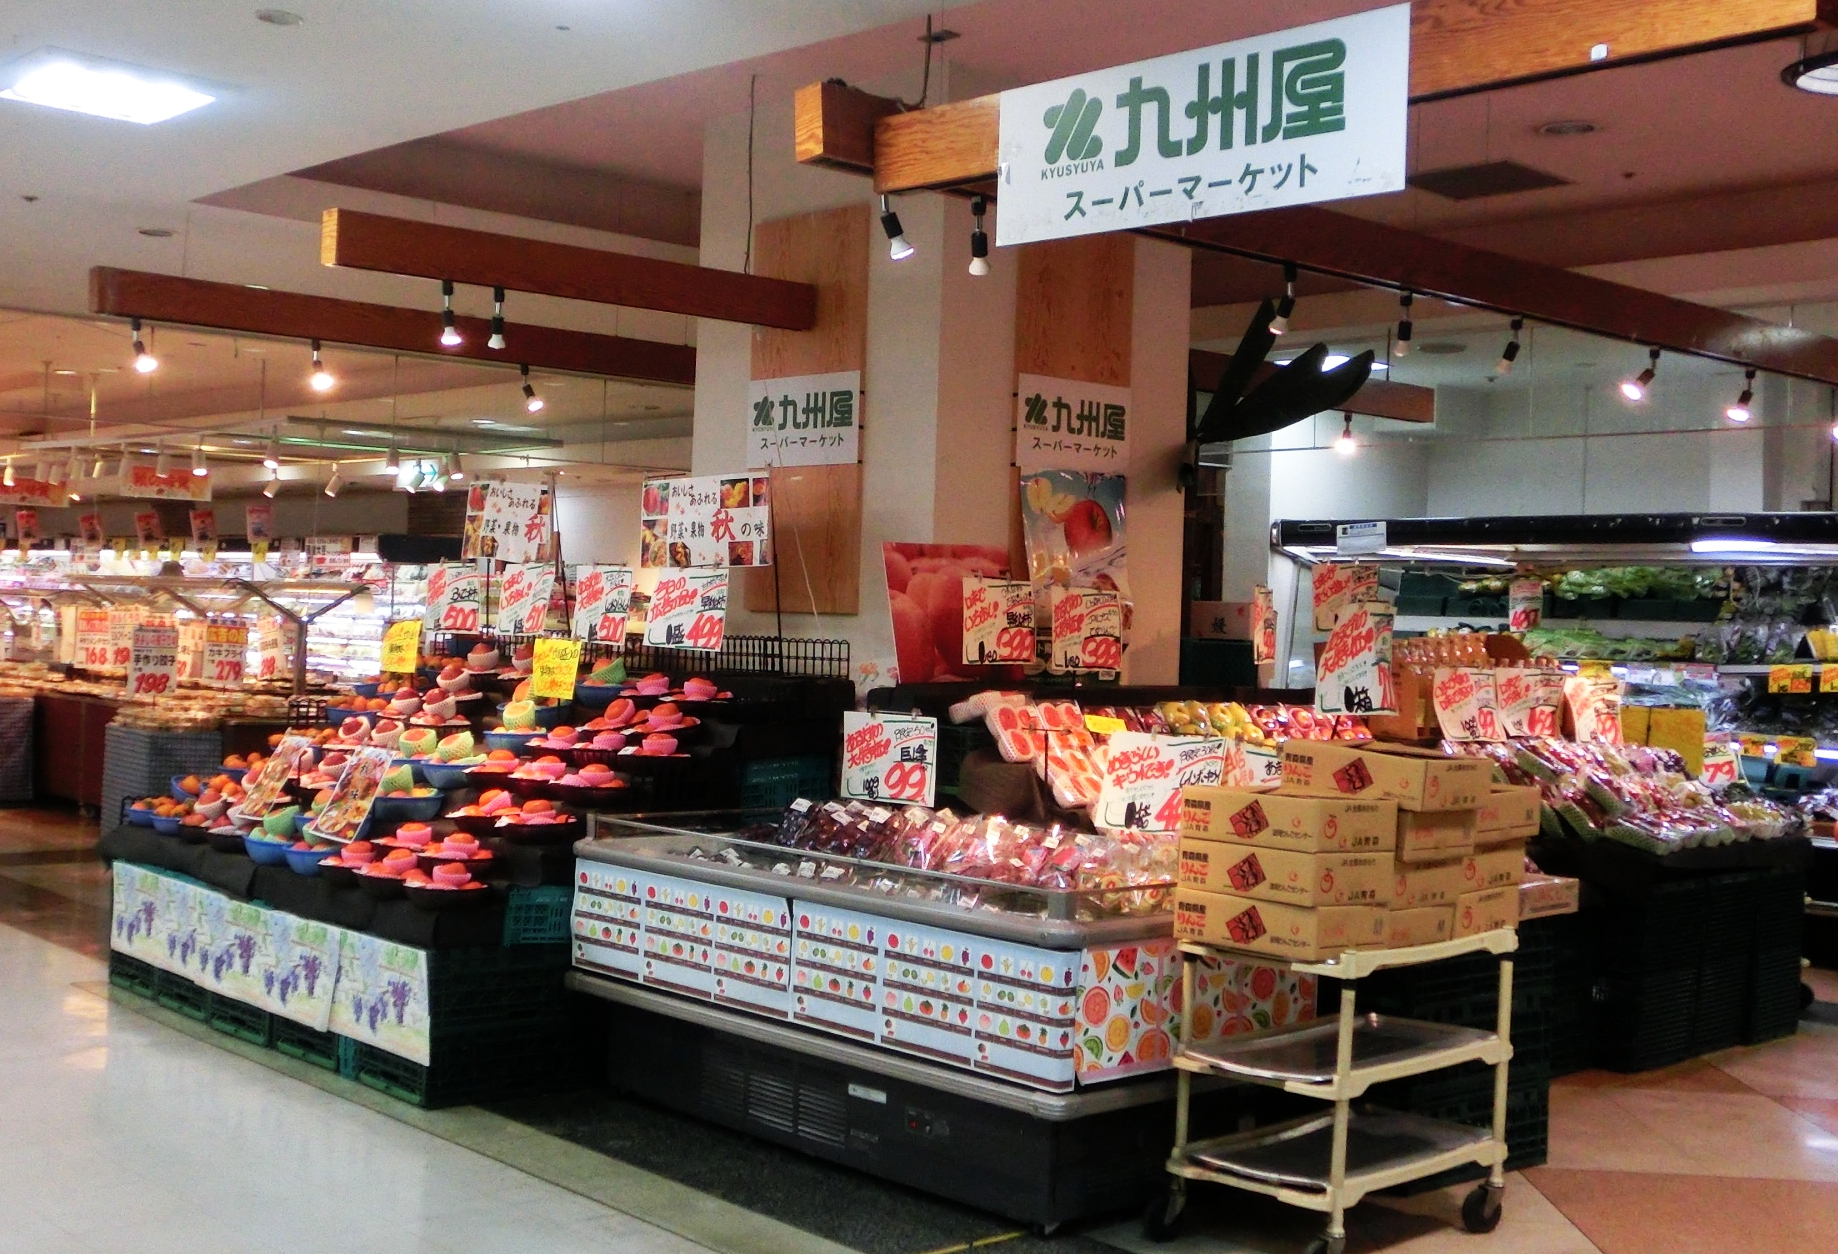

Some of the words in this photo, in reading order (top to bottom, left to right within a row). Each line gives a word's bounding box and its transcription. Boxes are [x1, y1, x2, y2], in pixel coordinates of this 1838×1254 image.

[1114, 37, 1347, 168] 九州屋
[1041, 159, 1105, 181] KYUSYUYA
[1064, 153, 1319, 221] スーパーマーケット
[778, 389, 853, 430] 九州屋
[1052, 396, 1126, 441] 九州屋
[760, 433, 844, 450] スーパーマーケット
[1033, 437, 1118, 459] スーパーマーケット
[671, 484, 695, 498] おいしさ
[689, 492, 718, 506] あふれる
[524, 514, 546, 543] 秋
[710, 508, 736, 543] 秋
[685, 613, 723, 648] 499
[215, 660, 243, 681] 279
[1285, 751, 1313, 767] 青森県産
[1284, 764, 1311, 778] りんご
[884, 762, 927, 800] 99
[1184, 799, 1211, 812] 青森県産
[1183, 810, 1211, 825] りんご
[1351, 836, 1379, 847] JA青森
[1182, 850, 1209, 864] 青森県産
[1180, 861, 1208, 876] りんご
[1348, 890, 1376, 901] JA青森
[1178, 902, 1206, 917] 青森県産
[1177, 914, 1206, 928] りんご
